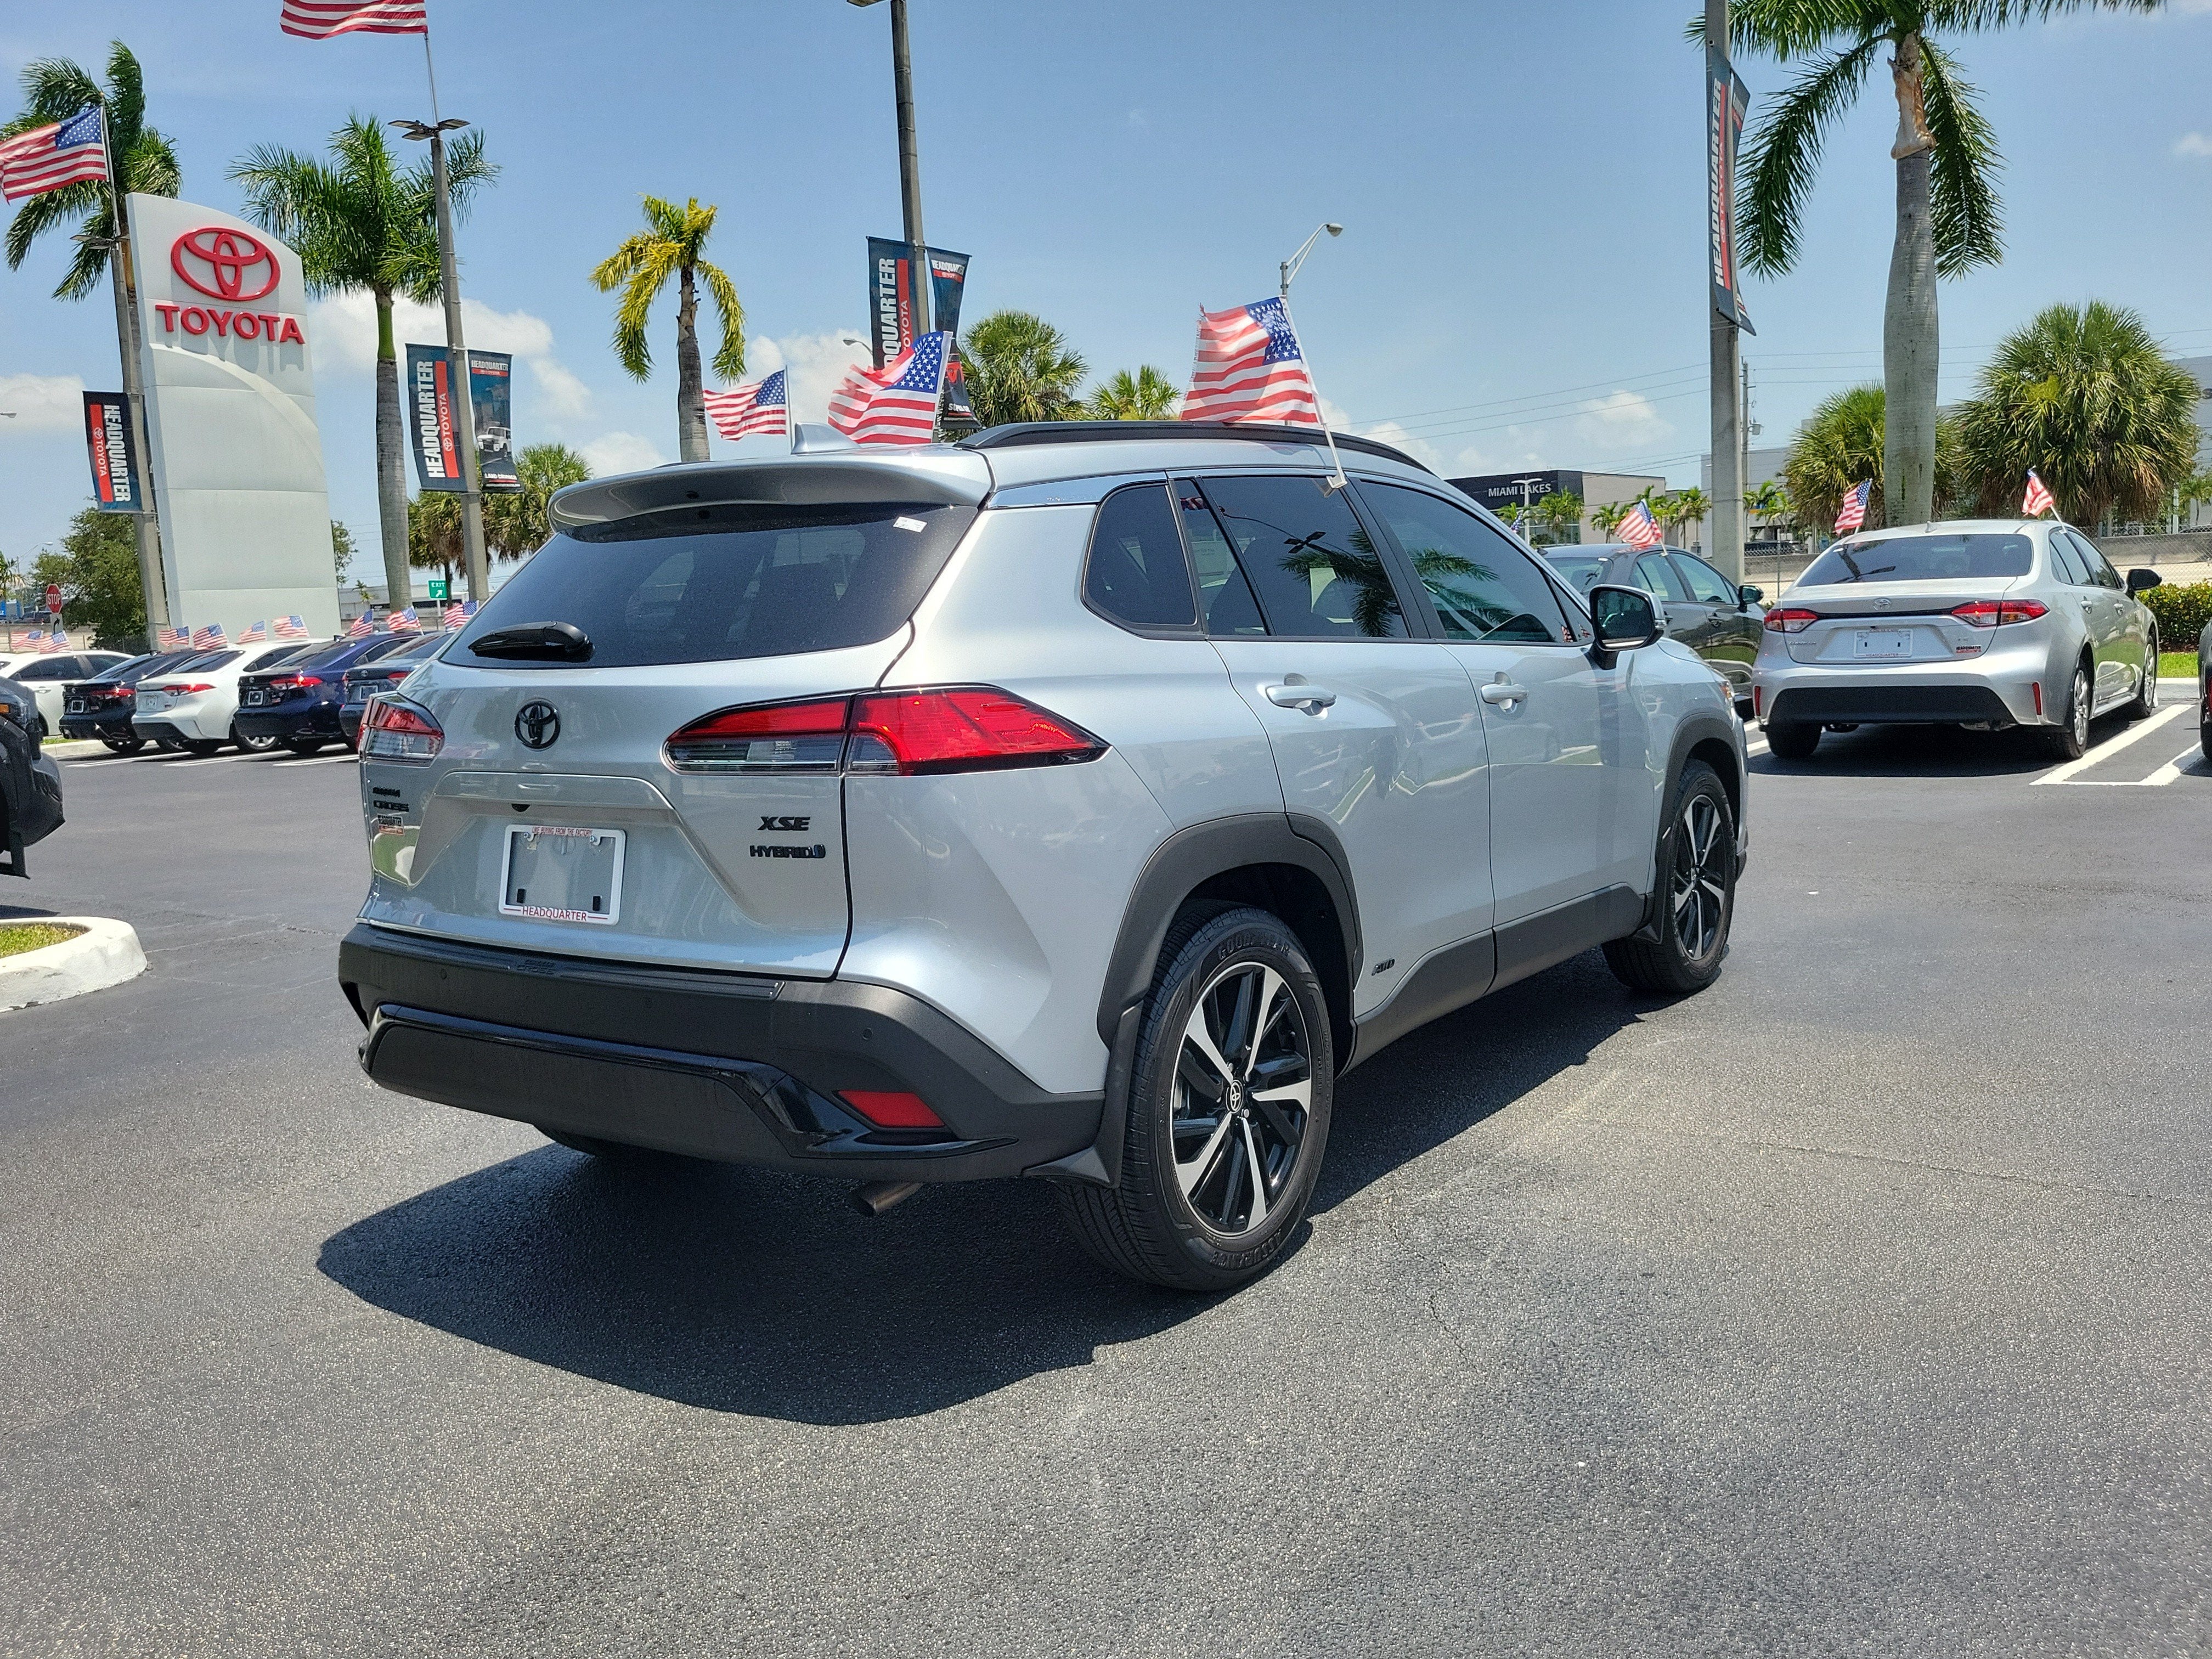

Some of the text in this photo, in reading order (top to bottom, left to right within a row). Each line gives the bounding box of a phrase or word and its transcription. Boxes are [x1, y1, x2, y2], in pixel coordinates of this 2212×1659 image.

[1711, 77, 1725, 287] HEADQUARTER
[155, 304, 306, 344] TOYOTA
[901, 300, 911, 351] OYOTA
[417, 361, 446, 478] HEADQUARTER
[440, 393, 452, 437] TOYOTA
[96, 440, 107, 476] TOYOTA
[104, 405, 131, 501] HEADQUARTER
[1488, 483, 1551, 497] MIAMI LAKES
[47, 594, 61, 605] STOP
[757, 816, 811, 831] XSE
[749, 845, 813, 859] HYBRID
[522, 906, 587, 921] HEADQUARTER
